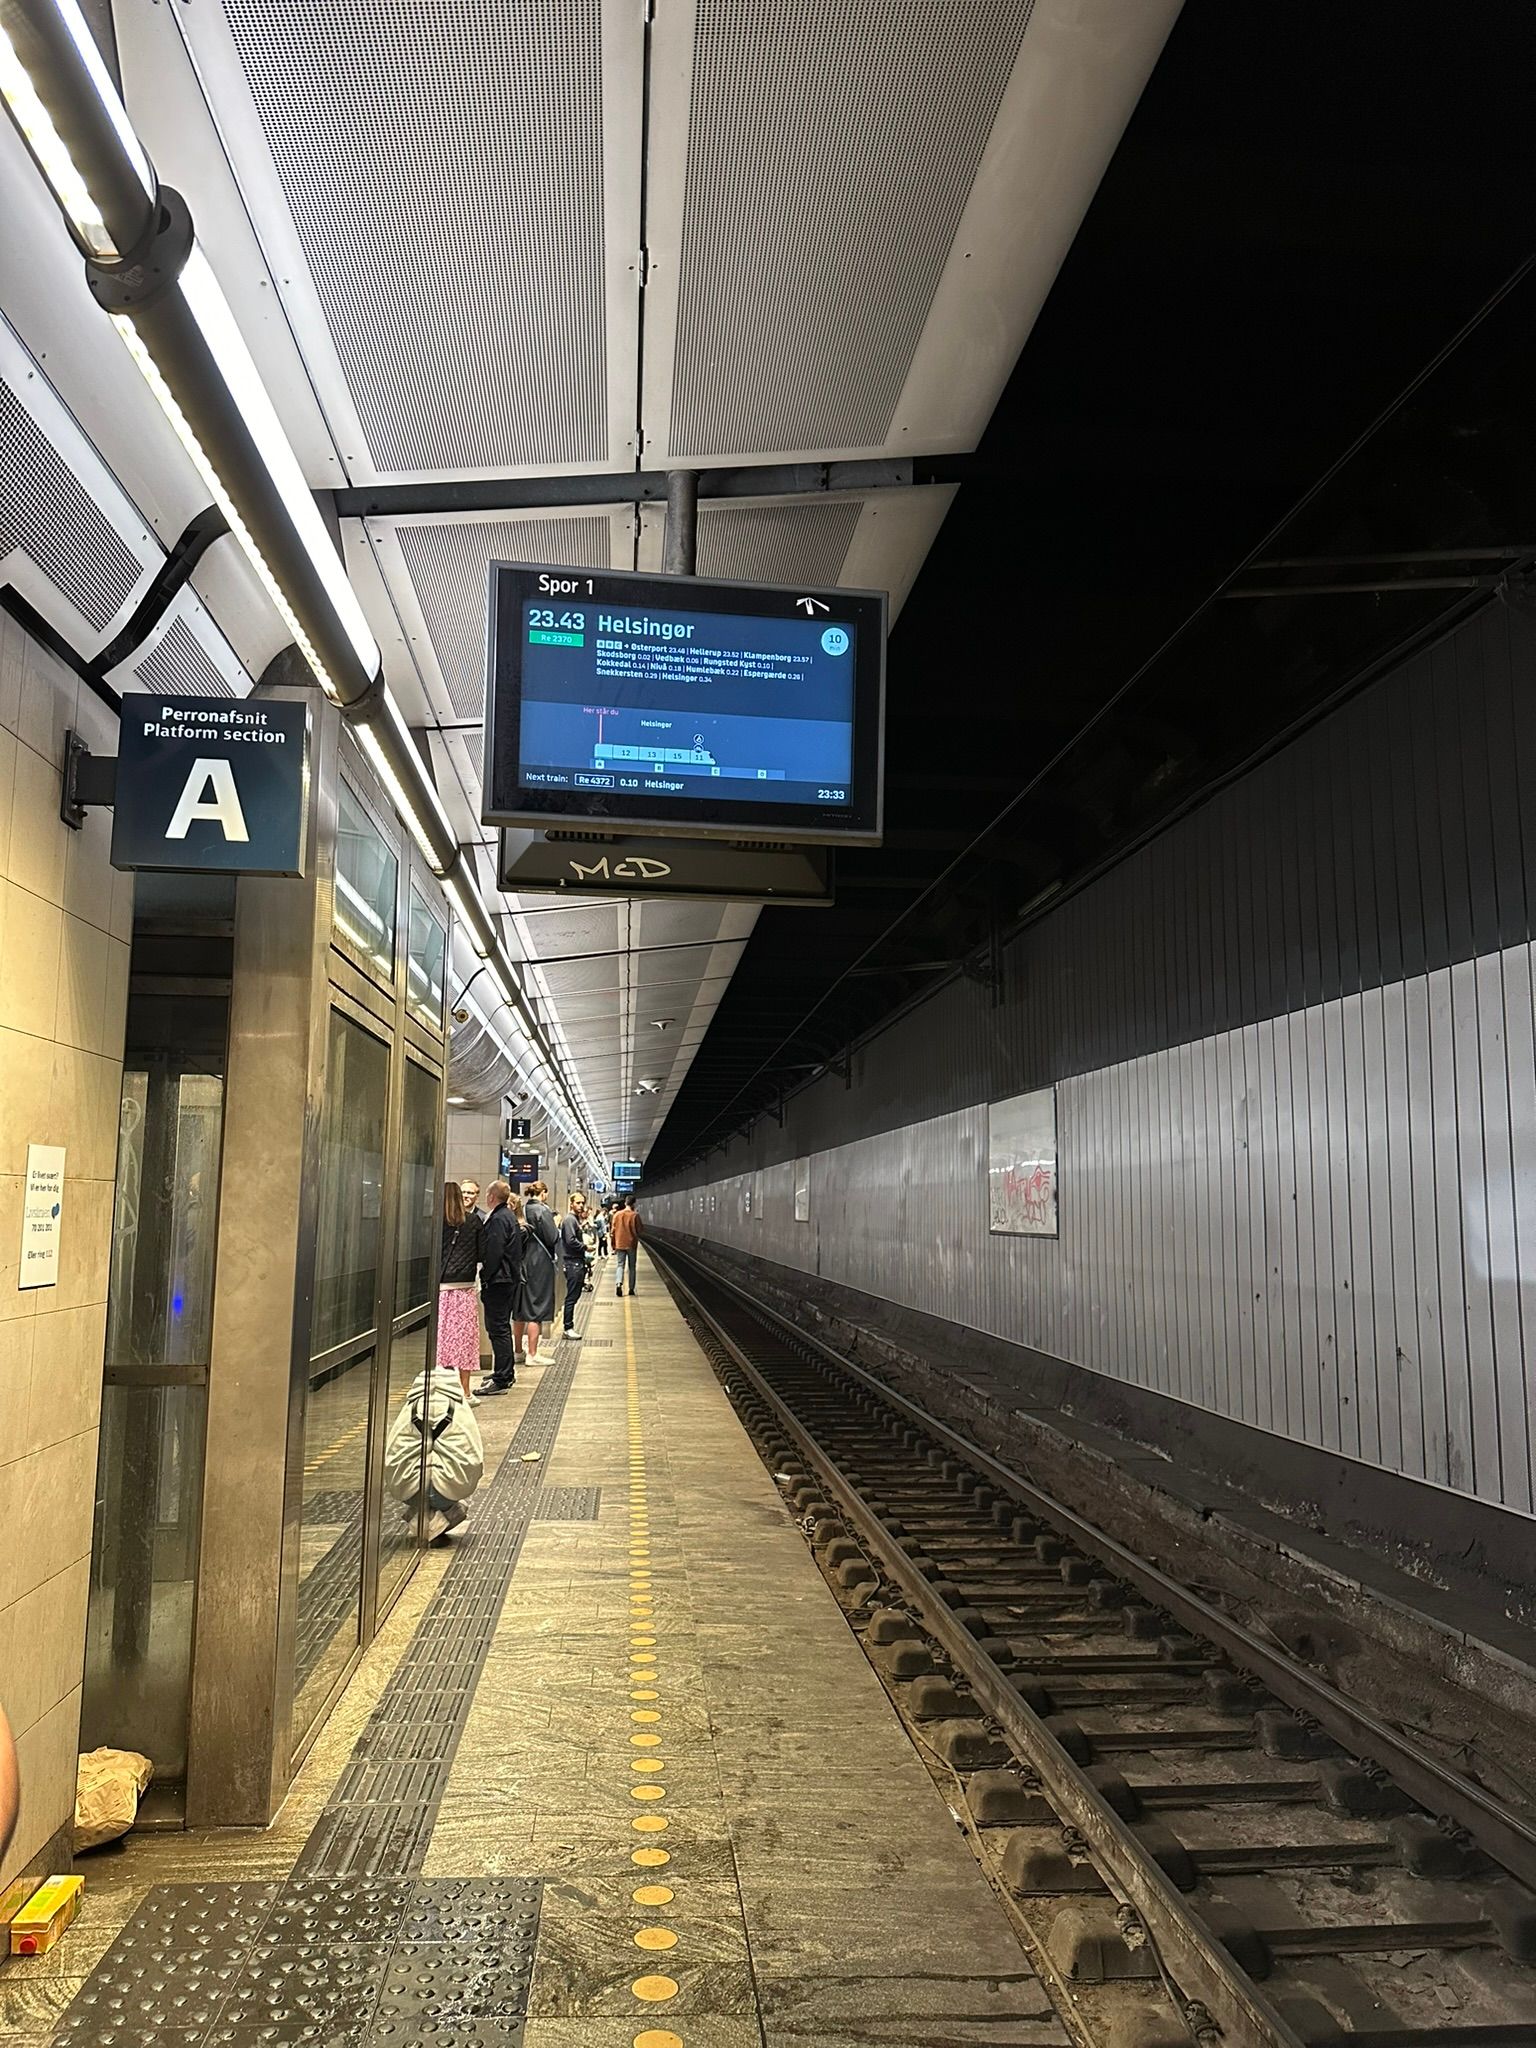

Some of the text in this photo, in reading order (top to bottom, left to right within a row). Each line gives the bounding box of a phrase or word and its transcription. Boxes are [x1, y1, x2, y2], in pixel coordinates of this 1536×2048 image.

[538, 574, 593, 596] Spor 1
[529, 609, 585, 630] 23.43
[598, 615, 695, 640] Helsingør
[541, 634, 573, 644] Re 2370
[829, 634, 842, 644] 10
[596, 650, 636, 660] Skodsborg
[655, 654, 684, 663] Vedbæk
[704, 658, 738, 666] Rungsted
[740, 660, 756, 668] Kyst
[631, 643, 667, 653] Østerport
[690, 648, 721, 657] Hellerup
[744, 652, 792, 662] Klampenborg
[596, 658, 632, 668] Kokkedal
[650, 662, 668, 670] Nivå
[686, 666, 726, 675] Humlebæk
[744, 670, 786, 680] Espergærde
[596, 668, 643, 678] Snekkersten
[662, 672, 698, 682] Helsingør
[161, 706, 268, 725] Perronafsnit
[610, 708, 618, 716] du
[143, 723, 286, 744] Platform section
[526, 772, 545, 782] Next
[546, 774, 568, 782] train:
[579, 776, 589, 784] Re
[620, 778, 638, 787] 0.10
[644, 780, 684, 790] Helsingør
[164, 758, 250, 842] A
[818, 790, 845, 800] 23:33
